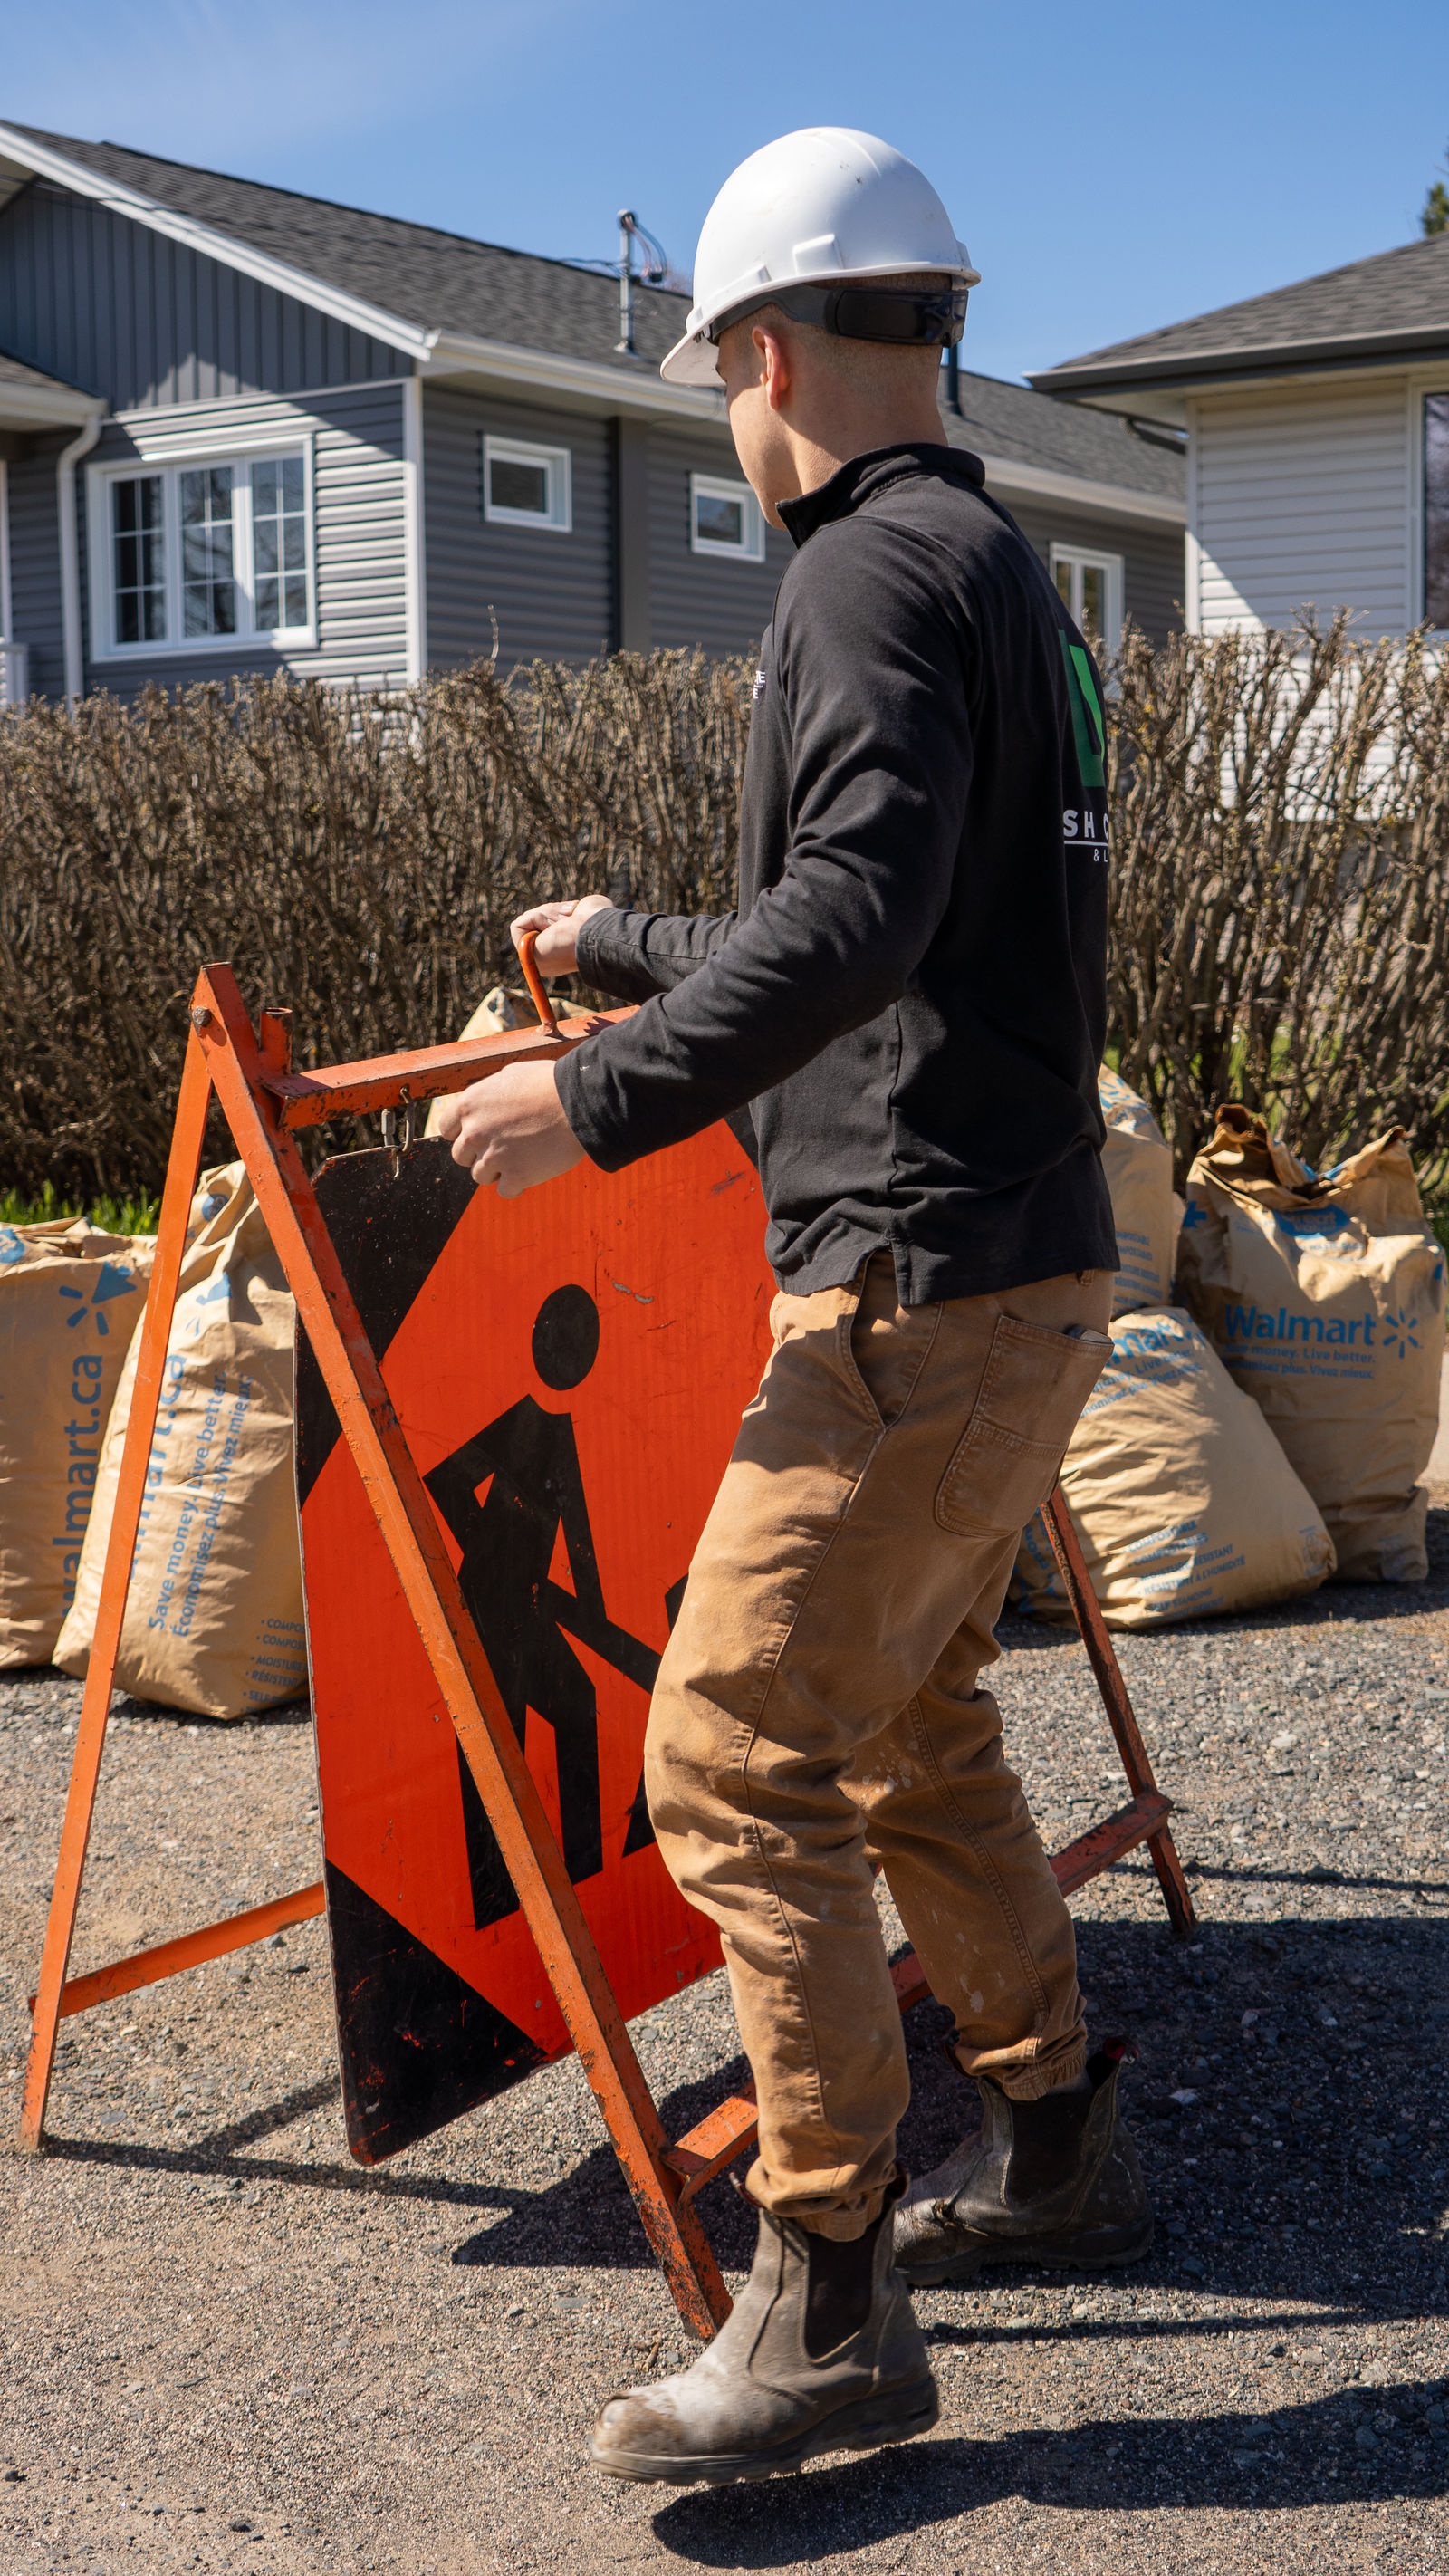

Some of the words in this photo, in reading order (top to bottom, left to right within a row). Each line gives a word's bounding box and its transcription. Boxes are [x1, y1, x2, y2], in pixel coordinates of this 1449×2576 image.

[1093, 848, 1099, 861] &
[1105, 1322, 1184, 1369] mart
[1225, 1303, 1376, 1346] Walmart
[1252, 1346, 1300, 1360] money.
[1303, 1348, 1329, 1360] Live
[1334, 1350, 1375, 1363] better.
[196, 1368, 226, 1442] better.
[186, 1447, 209, 1490] Live
[169, 1531, 215, 1637] Économisez
[212, 1437, 239, 1484] Vivez
[228, 1373, 253, 1434] mieux.
[167, 1496, 199, 1575] money.
[149, 1579, 175, 1629] Save
